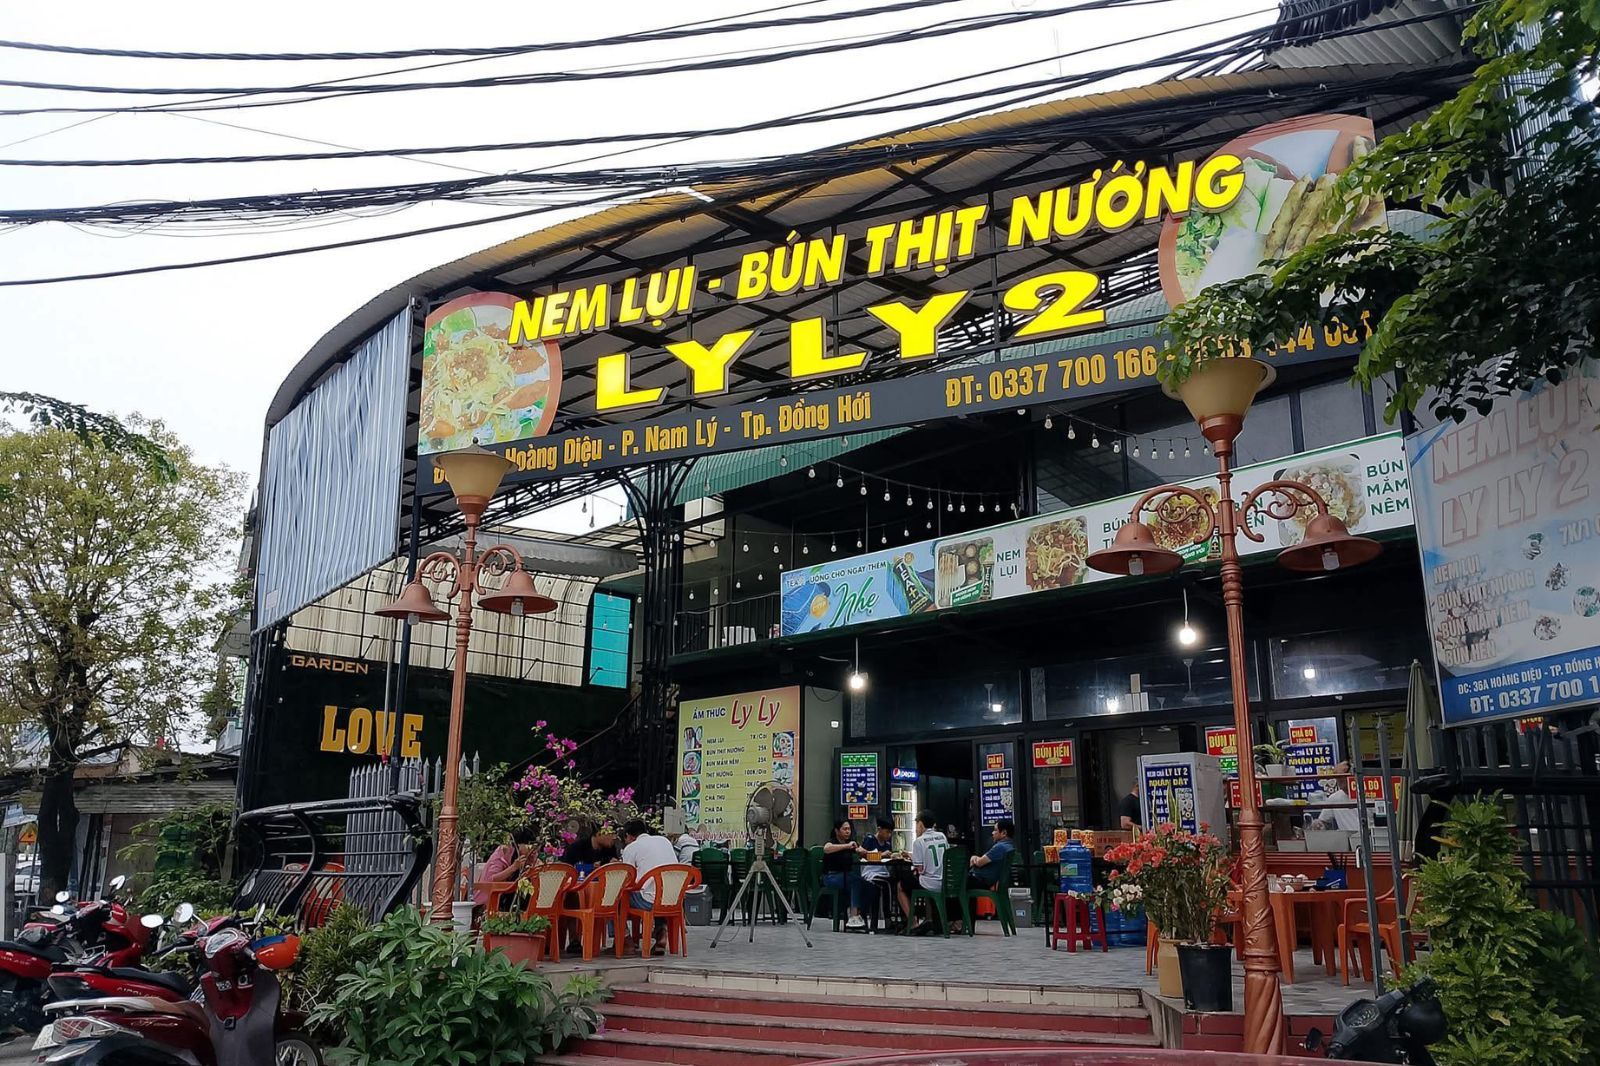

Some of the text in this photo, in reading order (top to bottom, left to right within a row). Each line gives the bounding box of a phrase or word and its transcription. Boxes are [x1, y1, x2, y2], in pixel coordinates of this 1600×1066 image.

[509, 283, 608, 346] NEM
[618, 265, 697, 329] LỤI
[737, 230, 847, 301] BÚN
[866, 205, 988, 274] THỊT
[1008, 153, 1246, 249] NƯỚNG
[596, 270, 1107, 411] LY LY 2
[945, 375, 983, 407] ĐT:
[989, 363, 1049, 401] 0337
[1058, 353, 1107, 389] 700
[1113, 345, 1158, 381] 166
[505, 443, 558, 472] Hoàng
[564, 436, 603, 467] Diệu
[622, 430, 639, 456] P.
[645, 424, 688, 452] Nam
[696, 416, 718, 447] Lý
[741, 410, 772, 440] Tp.
[779, 398, 829, 432] Đồng
[838, 391, 872, 423] Hới
[1367, 459, 1404, 478] BÚN
[1366, 476, 1409, 498] MẮM
[1442, 485, 1488, 547] LY
[1496, 462, 1546, 529] LY
[1557, 448, 1590, 508] 2
[1370, 497, 1410, 516] NÊM
[996, 549, 1021, 563] NEM
[831, 569, 846, 580] CHO
[1000, 564, 1018, 579] LỤI
[828, 577, 880, 628] Nhẹ
[291, 654, 369, 676] GARDEN
[1473, 679, 1489, 693] 36A
[1490, 672, 1519, 689] HOÀNG
[1521, 668, 1542, 684] DIỆU
[1550, 665, 1564, 677] TP.
[1470, 695, 1495, 714] ĐT:
[1499, 686, 1542, 709] 0337
[1547, 678, 1584, 701] 700
[731, 699, 753, 730] Ly
[758, 696, 781, 727] Ly
[320, 705, 425, 758] LOVE
[1208, 732, 1228, 748] BÚN
[1315, 747, 1324, 755] LY
[1324, 746, 1331, 755] 2
[1165, 767, 1173, 777] LY
[1174, 767, 1182, 776] LY
[1182, 767, 1188, 776] 2
